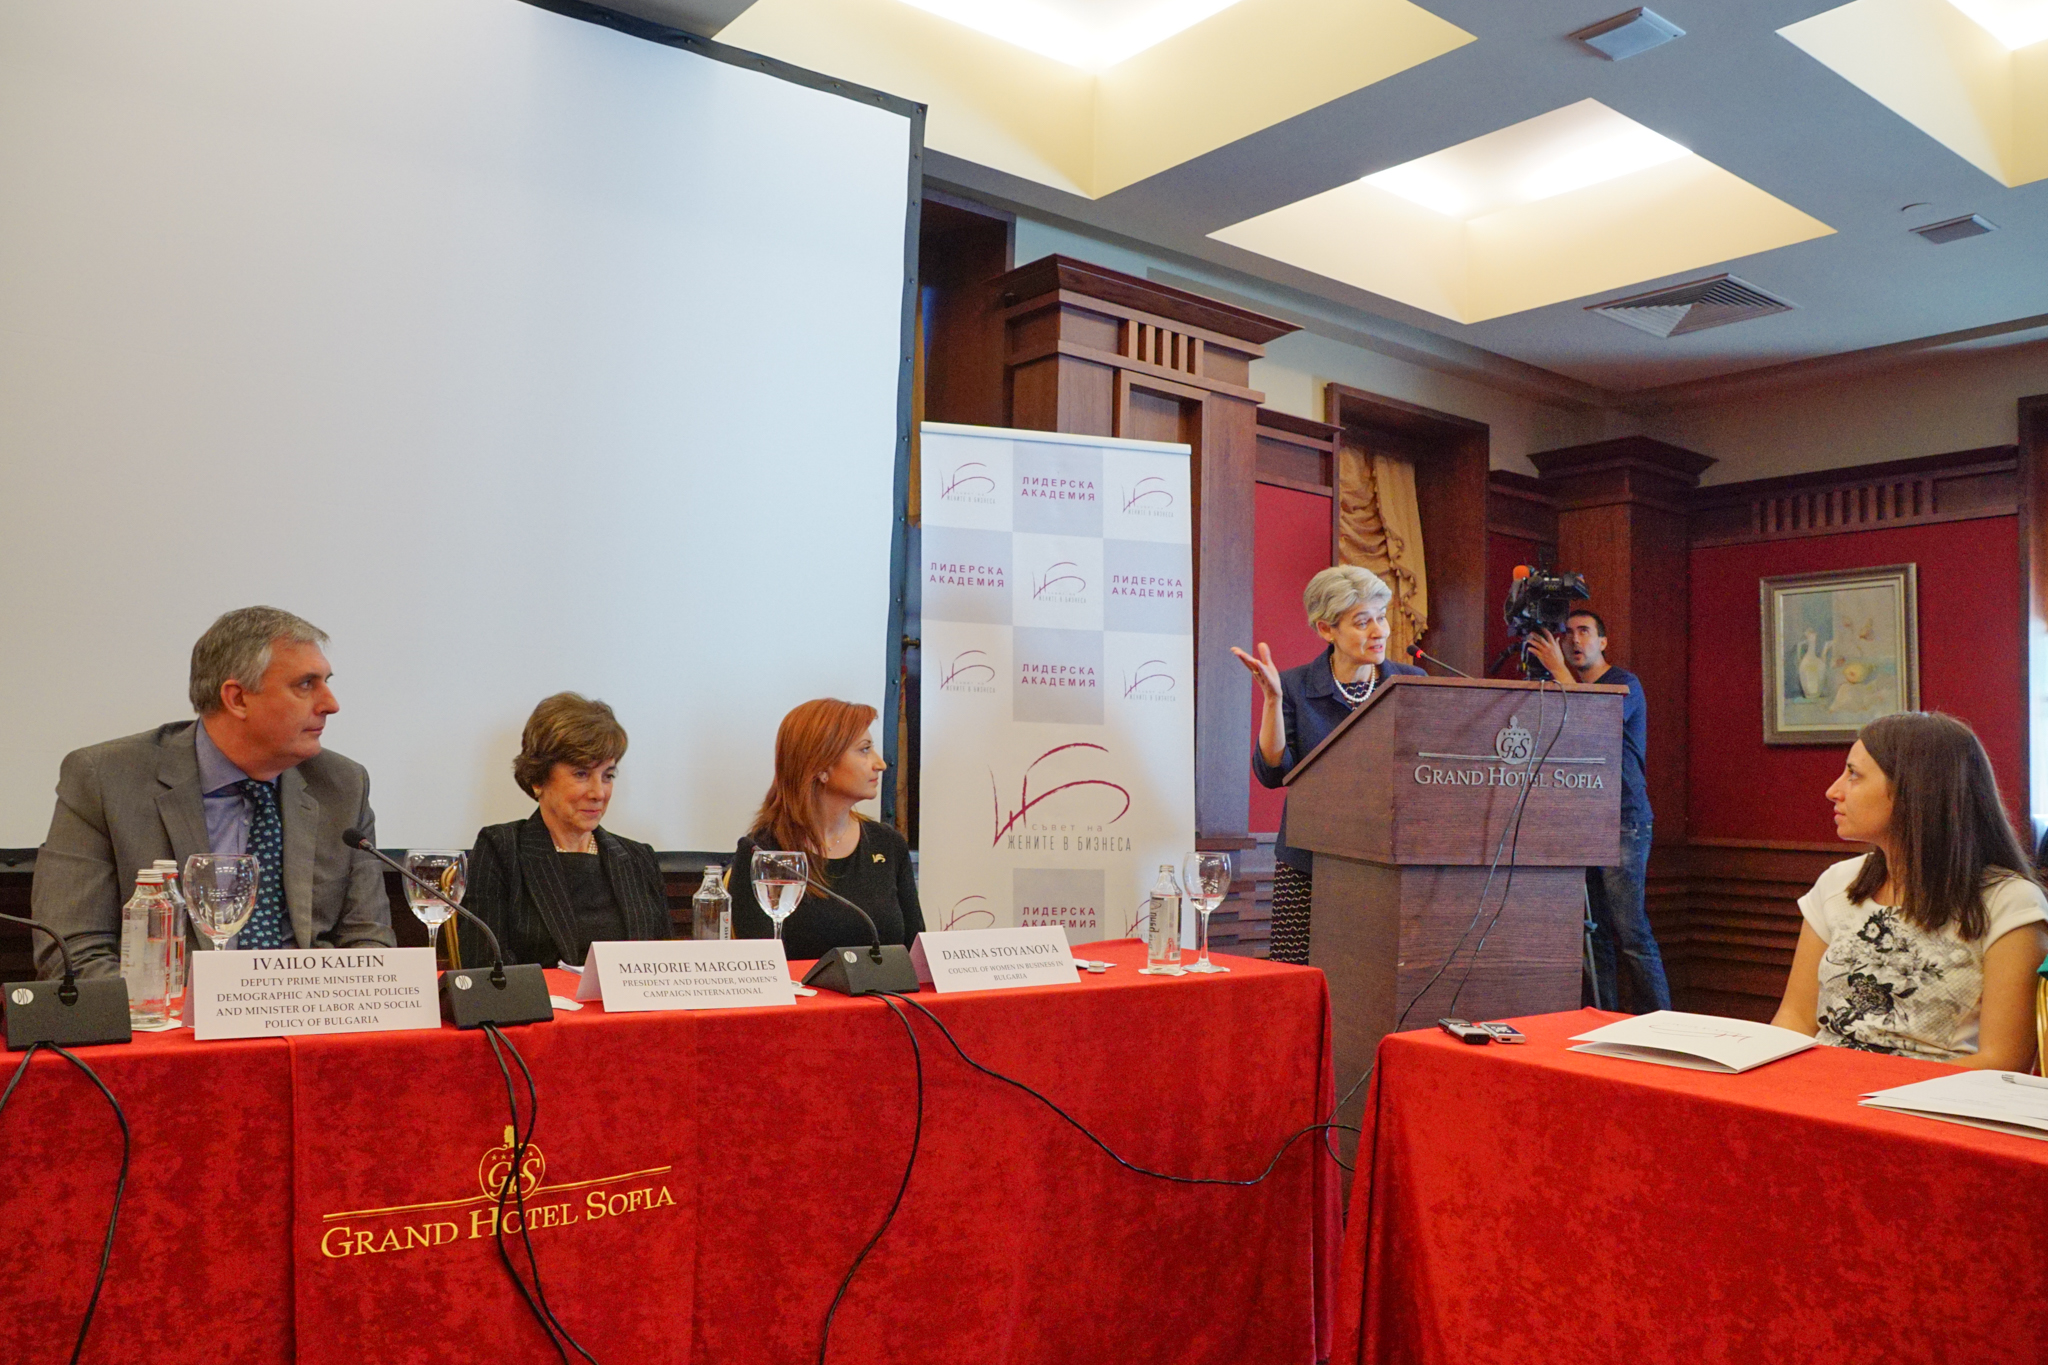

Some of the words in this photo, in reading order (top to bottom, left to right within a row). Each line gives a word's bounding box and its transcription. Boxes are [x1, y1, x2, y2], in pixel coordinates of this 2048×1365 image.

[1022, 476, 1095, 490] ЛИДЕРСКА
[1021, 488, 1095, 501] АКАДЕМИЯ
[930, 562, 1004, 576] ЛИДЕРСКА
[929, 574, 1005, 588] АКАДЕМИЯ
[1112, 575, 1183, 588] ЛИДЕРСКА
[1111, 587, 1184, 599] АКАДЕМИЯ
[1022, 663, 1095, 676] ЛИДЕРСКА
[1021, 676, 1096, 688] АКАДЕМИЯ
[1007, 834, 1055, 851] ЖЕНИТЕ
[1063, 836, 1069, 851] В
[1077, 836, 1132, 852] БИЗНЕСА
[1022, 906, 1096, 916] ЛИДЕРСКА
[942, 948, 989, 961] DARINA
[990, 944, 1059, 958] STOYANOVA
[252, 956, 317, 971] IVAILO
[321, 954, 385, 969] KALFIN
[619, 961, 692, 976] MARJORIE
[694, 959, 776, 972] MARGOLIES
[948, 967, 979, 975] COUNCIL
[990, 963, 1015, 972] WOMEN
[1025, 961, 1056, 969] BUSINESS
[1056, 960, 1064, 968] IN
[240, 977, 284, 988] DEPUTY
[287, 976, 321, 986] PRIME
[323, 974, 375, 985] MINISTER
[377, 973, 398, 983] FOR
[622, 979, 670, 987] PRESIDENT
[673, 978, 692, 986] AND
[694, 977, 737, 986] FOUNDER,
[994, 973, 1028, 982] BULGARIA
[217, 991, 303, 1003] DEMOGRAPHIC
[305, 990, 331, 999] AND
[332, 988, 372, 998] SOCIAL
[374, 986, 421, 996] POLICIES
[643, 989, 693, 998] CAMPAIGN
[694, 987, 764, 996] INTERNATIONAL
[216, 1007, 243, 1017] AND
[245, 1004, 300, 1015] MINISTER
[302, 1003, 317, 1013] OF
[319, 1002, 356, 1012] LABOR
[358, 1001, 383, 1010] AND
[384, 1000, 423, 1009] SOCIAL
[265, 1018, 305, 1028] POLICY
[307, 1018, 322, 1027] OF
[324, 1015, 380, 1025] BULGARIA
